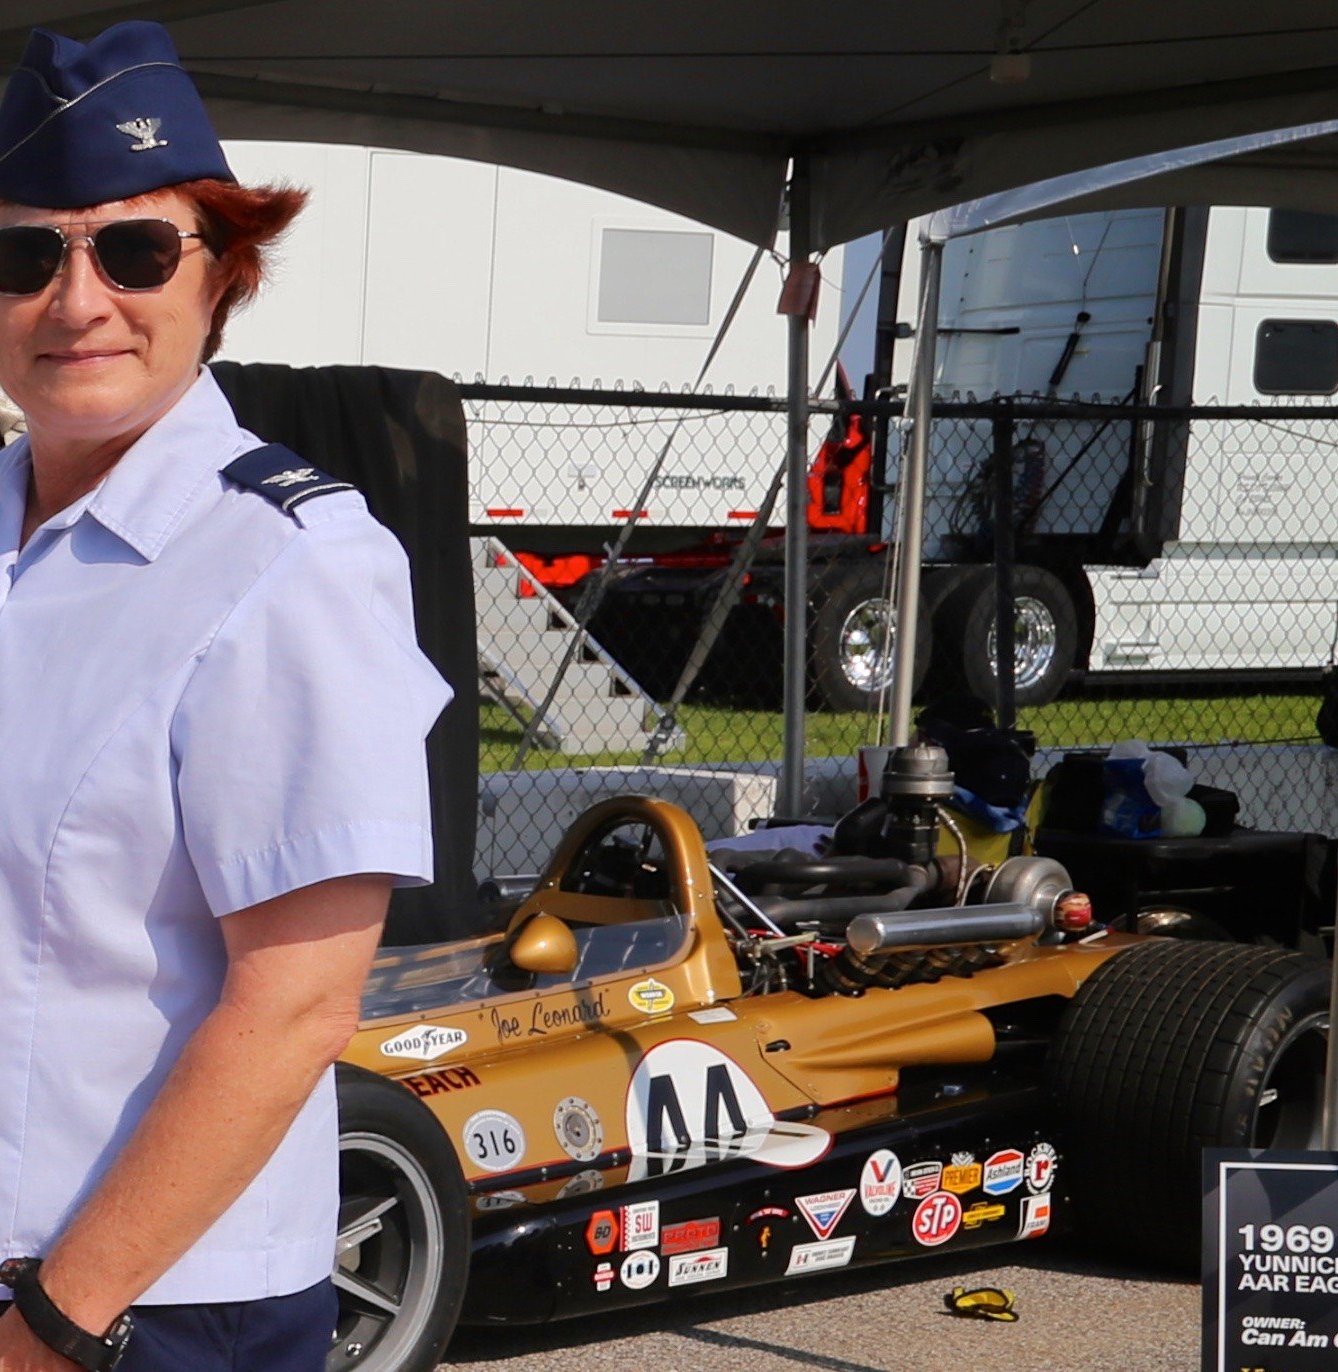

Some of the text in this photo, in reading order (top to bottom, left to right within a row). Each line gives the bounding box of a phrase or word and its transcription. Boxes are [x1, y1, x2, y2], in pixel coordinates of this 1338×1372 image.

[473, 1129, 515, 1159] 316
[945, 1168, 979, 1186] PREMIER
[987, 1163, 1021, 1179] Ashland
[804, 1191, 845, 1205] WAGNER
[635, 1212, 653, 1234] SW
[918, 1197, 955, 1235] STP
[1025, 1218, 1047, 1229] FRAM
[1238, 1223, 1335, 1254] 1969
[676, 1260, 721, 1277] SUNNEN
[1238, 1273, 1338, 1294] AAR EAG
[1241, 1315, 1306, 1330] OWNER:
[1241, 1328, 1285, 1346] Can
[1288, 1330, 1329, 1348] Am
